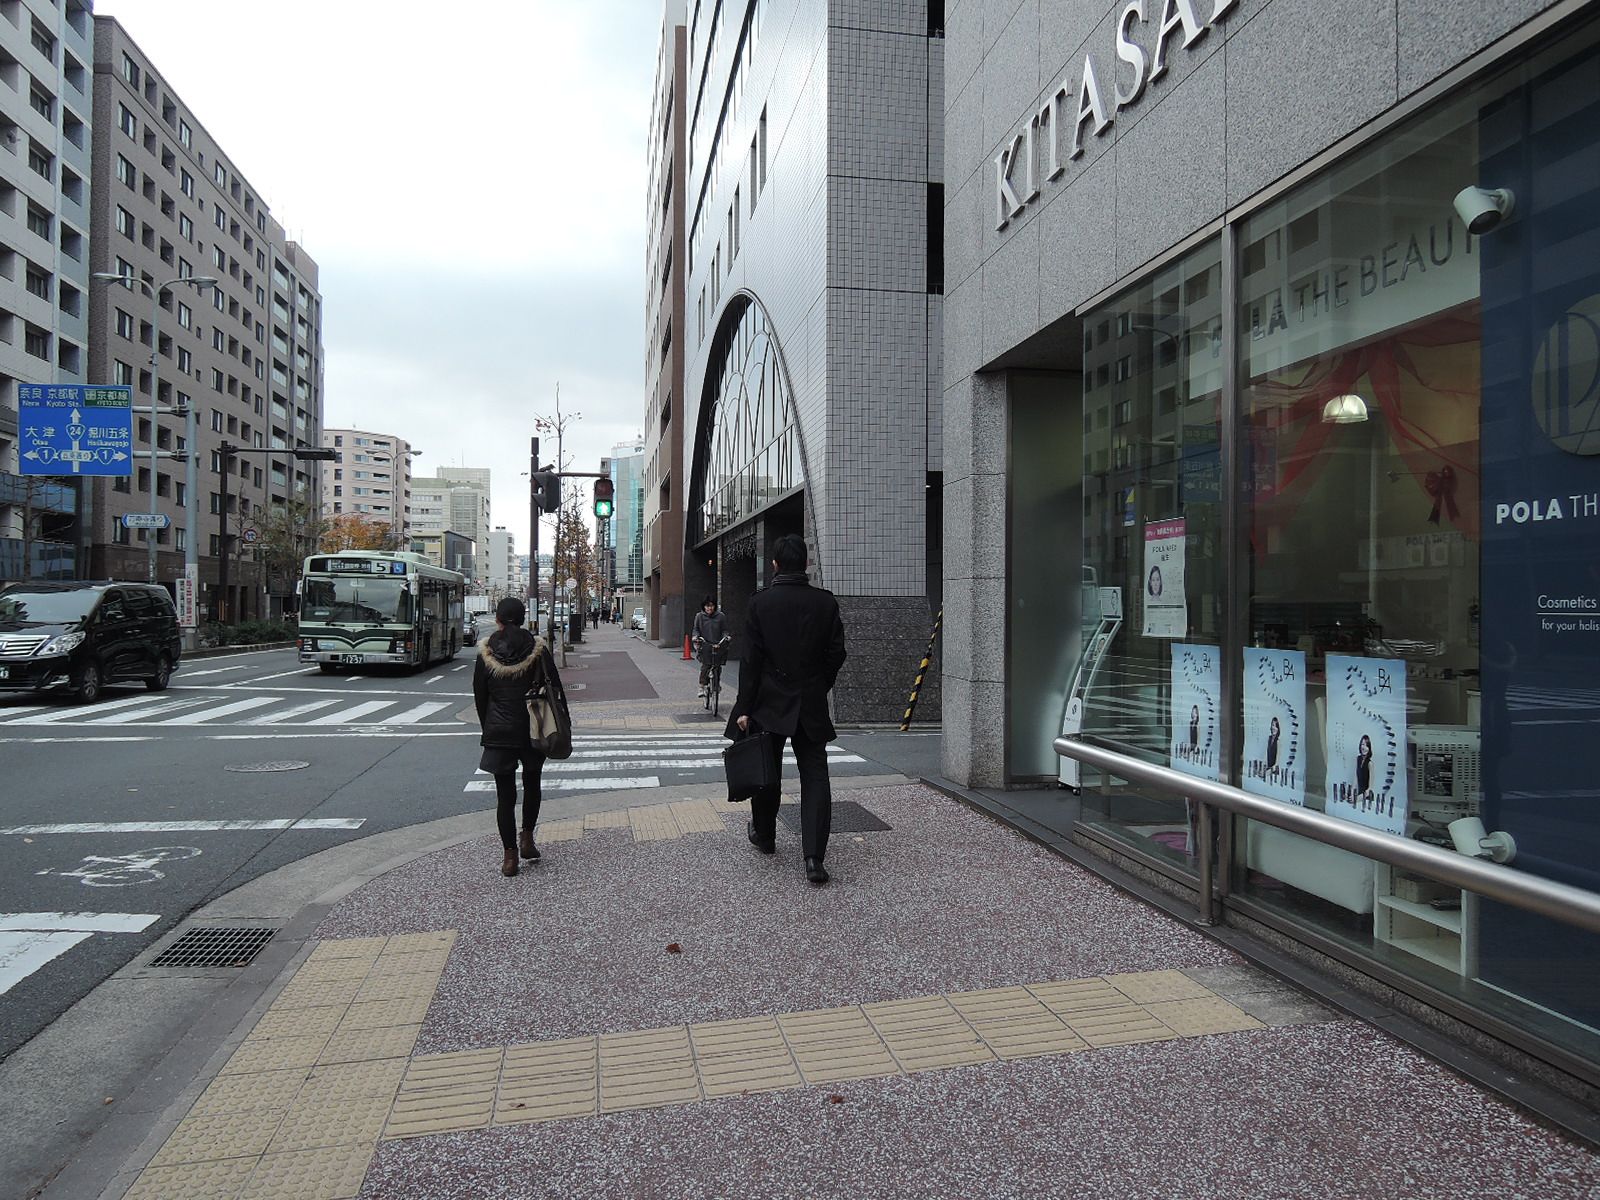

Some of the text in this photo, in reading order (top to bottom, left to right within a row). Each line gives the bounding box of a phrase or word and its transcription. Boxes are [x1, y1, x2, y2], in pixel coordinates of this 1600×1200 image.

[995, 0, 1240, 231] KITASA
[1293, 265, 1350, 322] THE
[25, 426, 56, 438] 大津
[69, 426, 81, 436] 24
[42, 449, 48, 460] 1
[102, 450, 108, 460] 1
[1496, 498, 1563, 524] POLA
[375, 562, 387, 572] 5
[1537, 594, 1597, 609] Cosmetics
[1541, 619, 1553, 630] for
[1556, 622, 1576, 633] your
